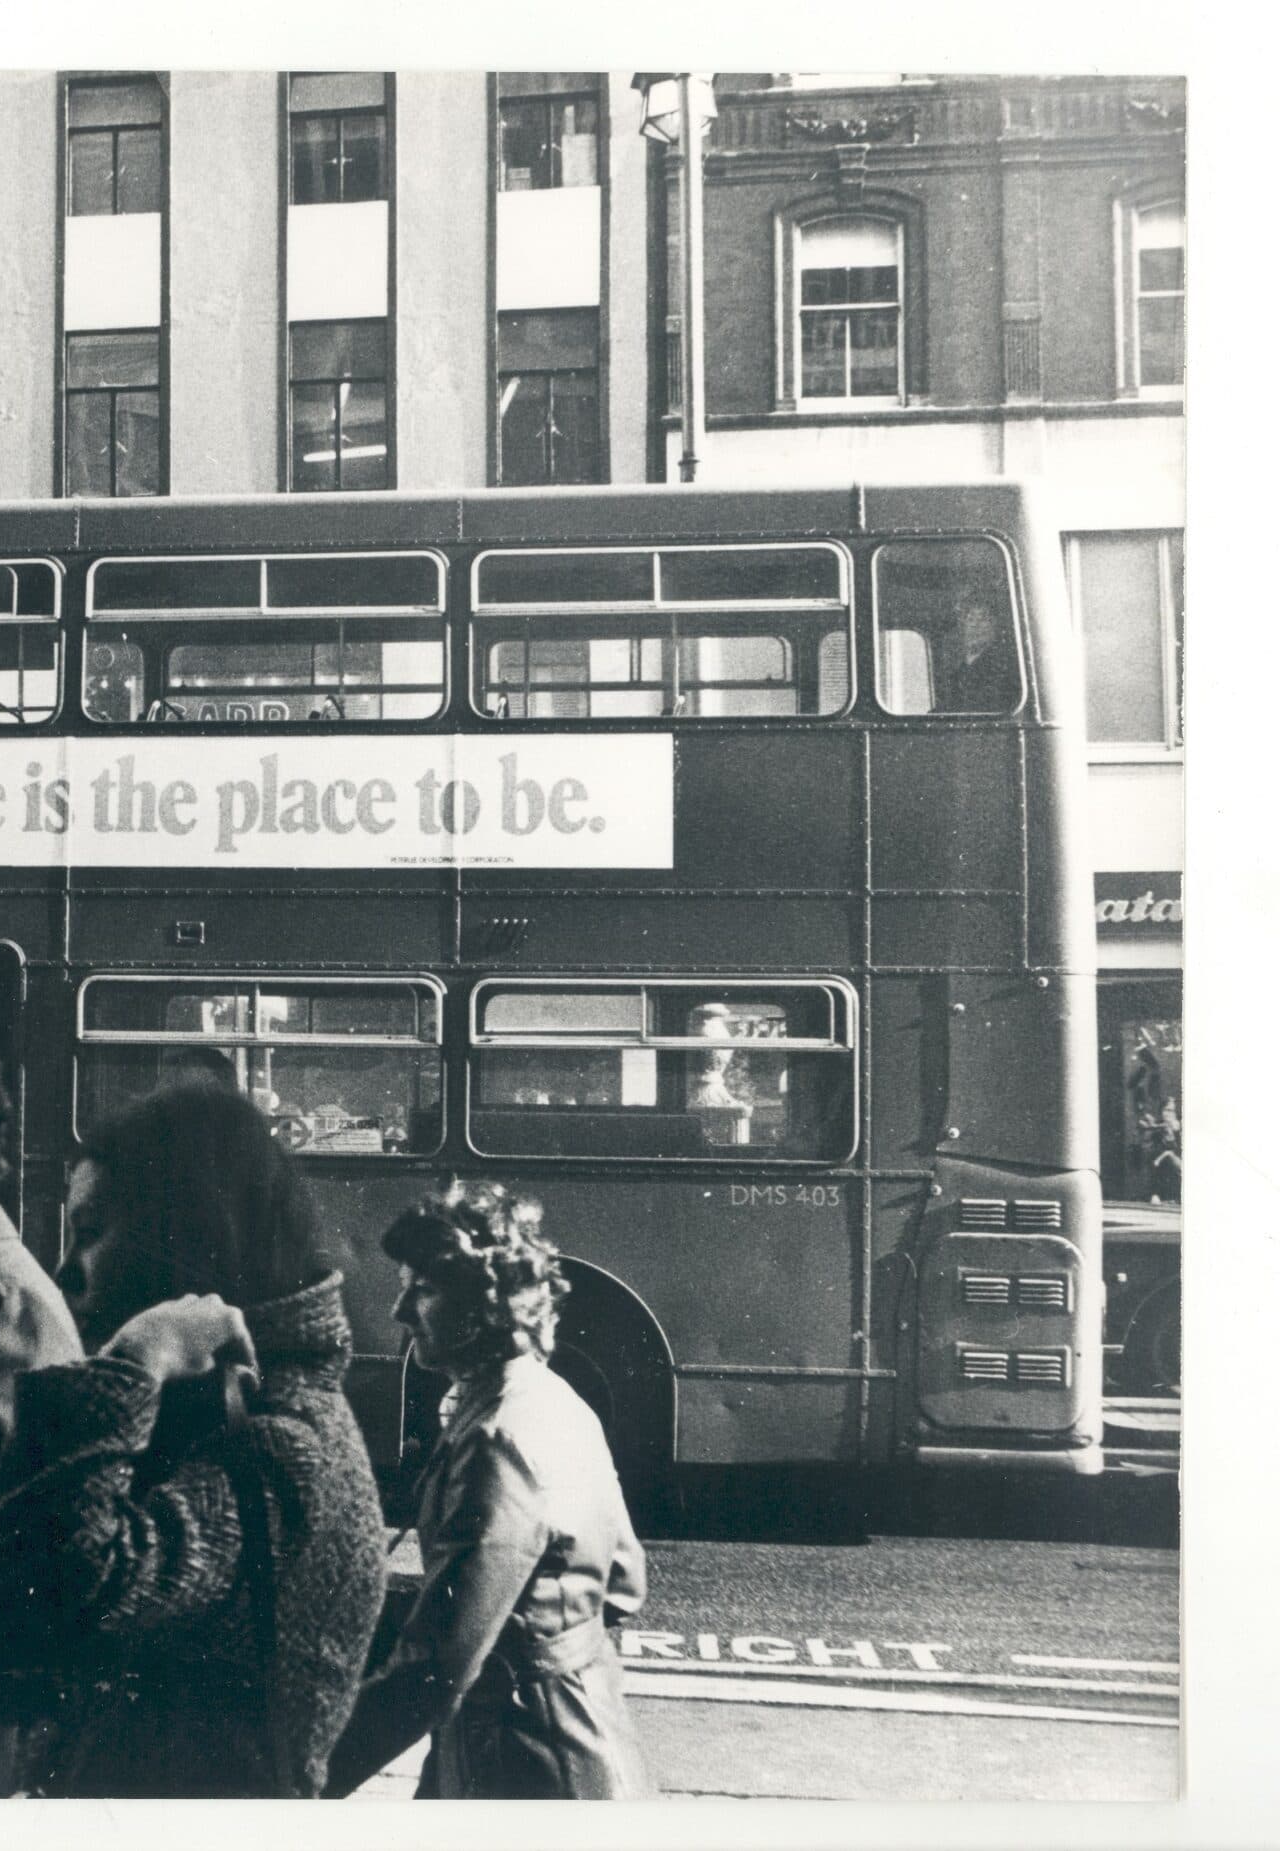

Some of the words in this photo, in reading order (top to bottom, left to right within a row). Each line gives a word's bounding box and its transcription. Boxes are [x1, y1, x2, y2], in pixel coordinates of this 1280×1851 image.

[21, 760, 70, 835] is
[90, 753, 198, 836] the
[214, 752, 397, 854] place
[414, 767, 481, 835] to
[498, 751, 607, 836] be.
[730, 1185, 787, 1206] DMS
[795, 1186, 840, 1207] 403
[620, 1629, 953, 1671] RIGHT
